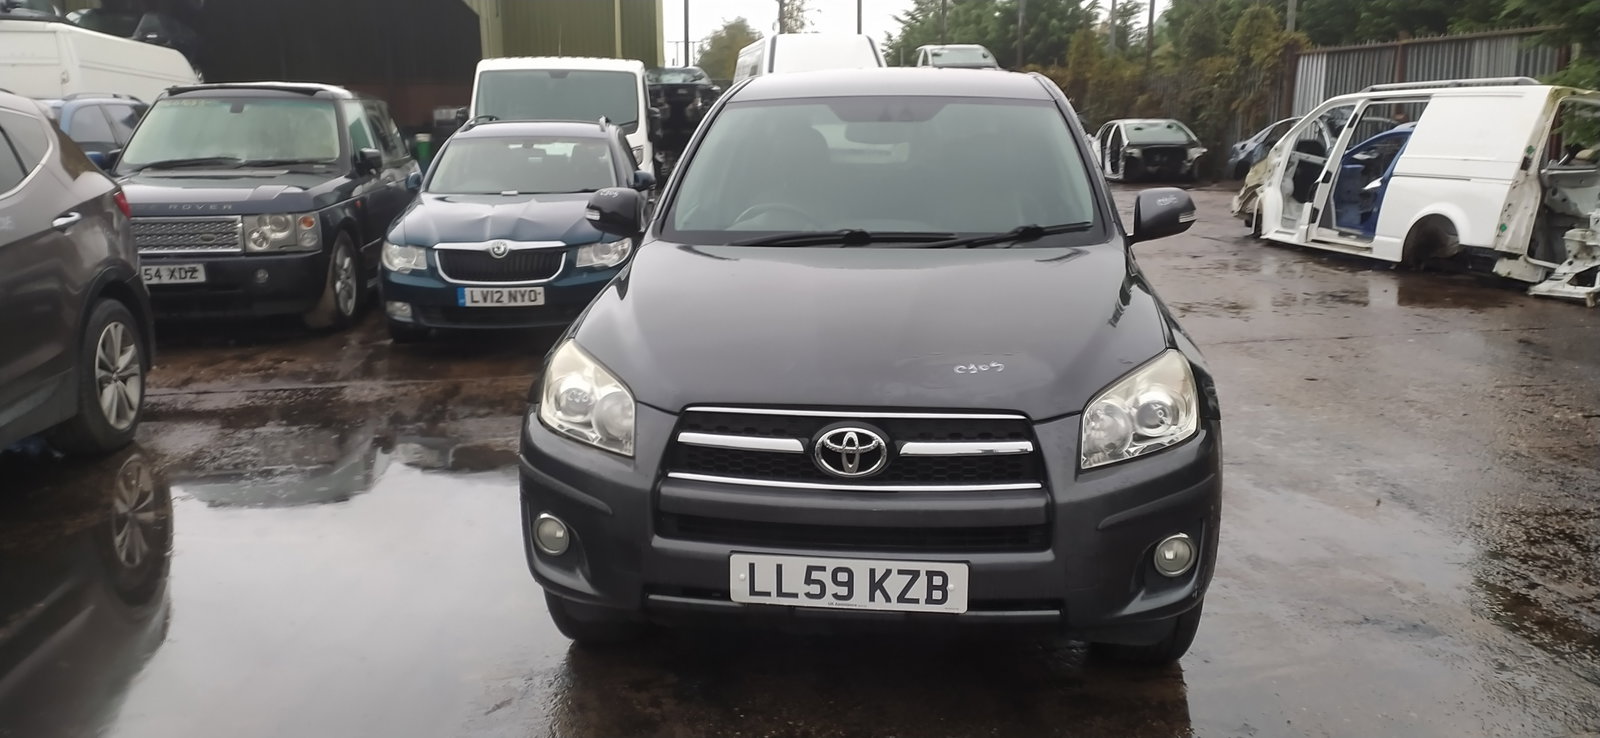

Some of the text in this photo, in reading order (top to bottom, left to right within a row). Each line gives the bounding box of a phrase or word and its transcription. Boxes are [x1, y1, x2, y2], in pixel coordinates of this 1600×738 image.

[143, 268, 162, 281] 54
[470, 289, 538, 303] LV12 NYO
[748, 562, 950, 605] LL59 KZB
